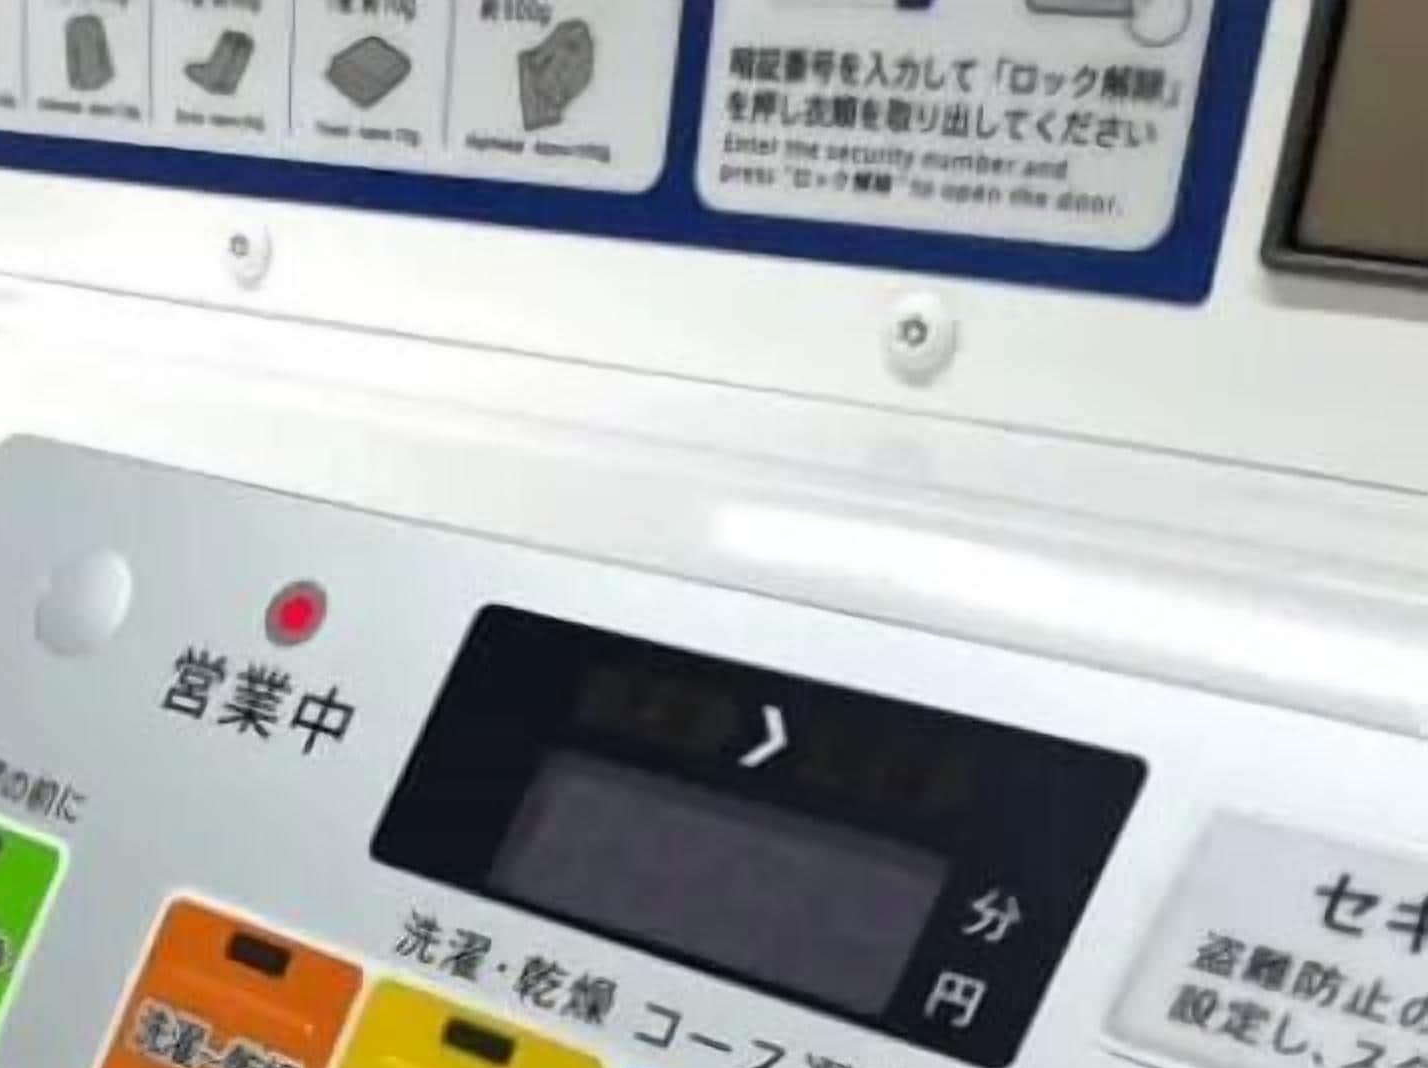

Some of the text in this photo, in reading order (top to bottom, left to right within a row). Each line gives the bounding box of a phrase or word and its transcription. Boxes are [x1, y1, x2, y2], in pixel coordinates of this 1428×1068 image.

[160, 643, 356, 756] 営業中
[961, 886, 1021, 942] 分
[924, 970, 987, 1028] 円
